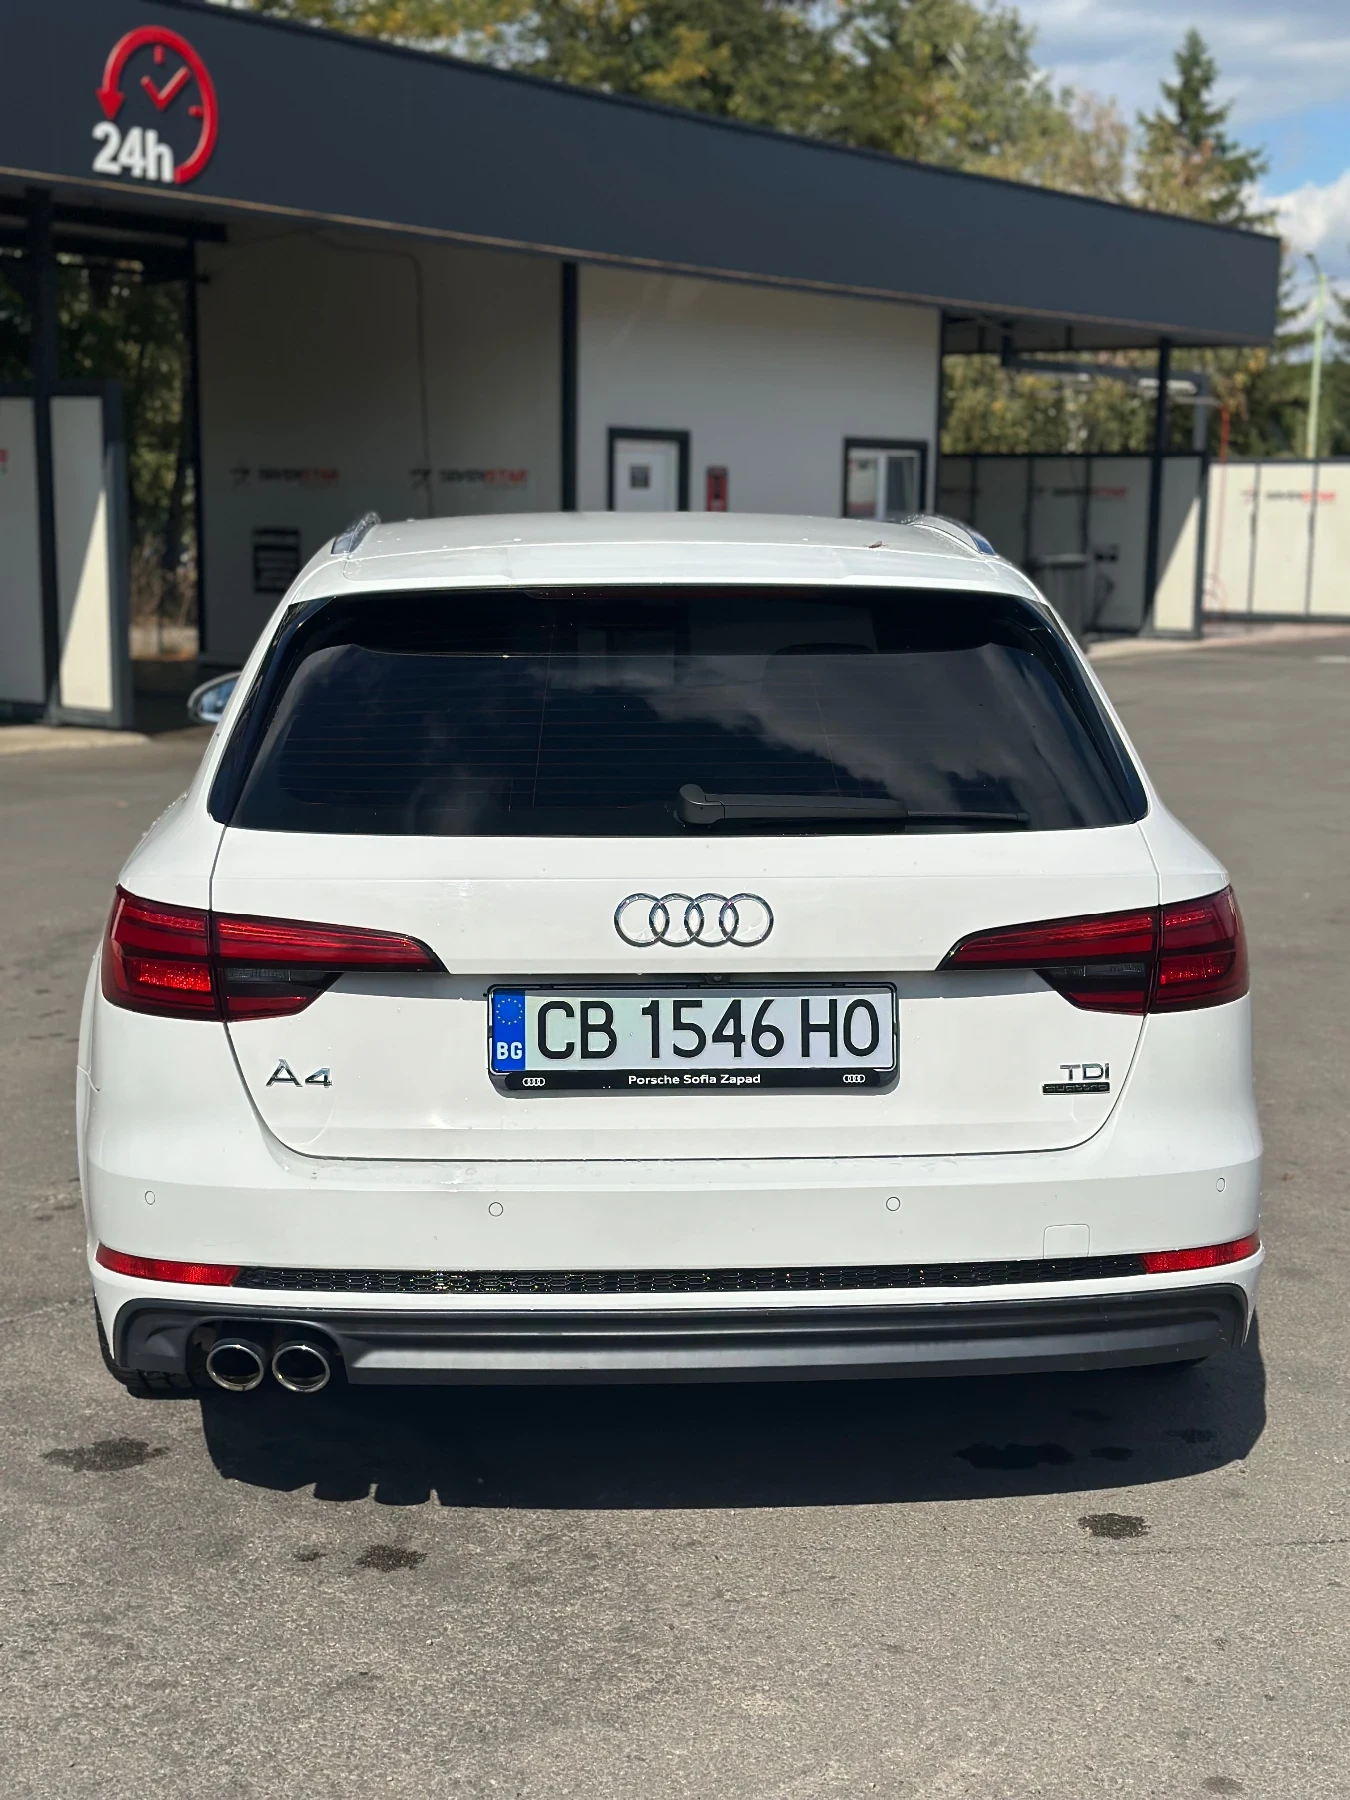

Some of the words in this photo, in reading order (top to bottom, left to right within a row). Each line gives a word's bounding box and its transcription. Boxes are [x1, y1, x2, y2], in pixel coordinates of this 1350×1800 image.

[92, 120, 174, 183] 24h
[537, 1000, 617, 1059] CB
[641, 998, 785, 1059] 1546
[496, 1041, 523, 1060] BG
[265, 1058, 333, 1089] A4
[628, 1075, 680, 1085] Porsche
[683, 1074, 717, 1084] Sofia
[720, 1074, 761, 1086] Zapad
